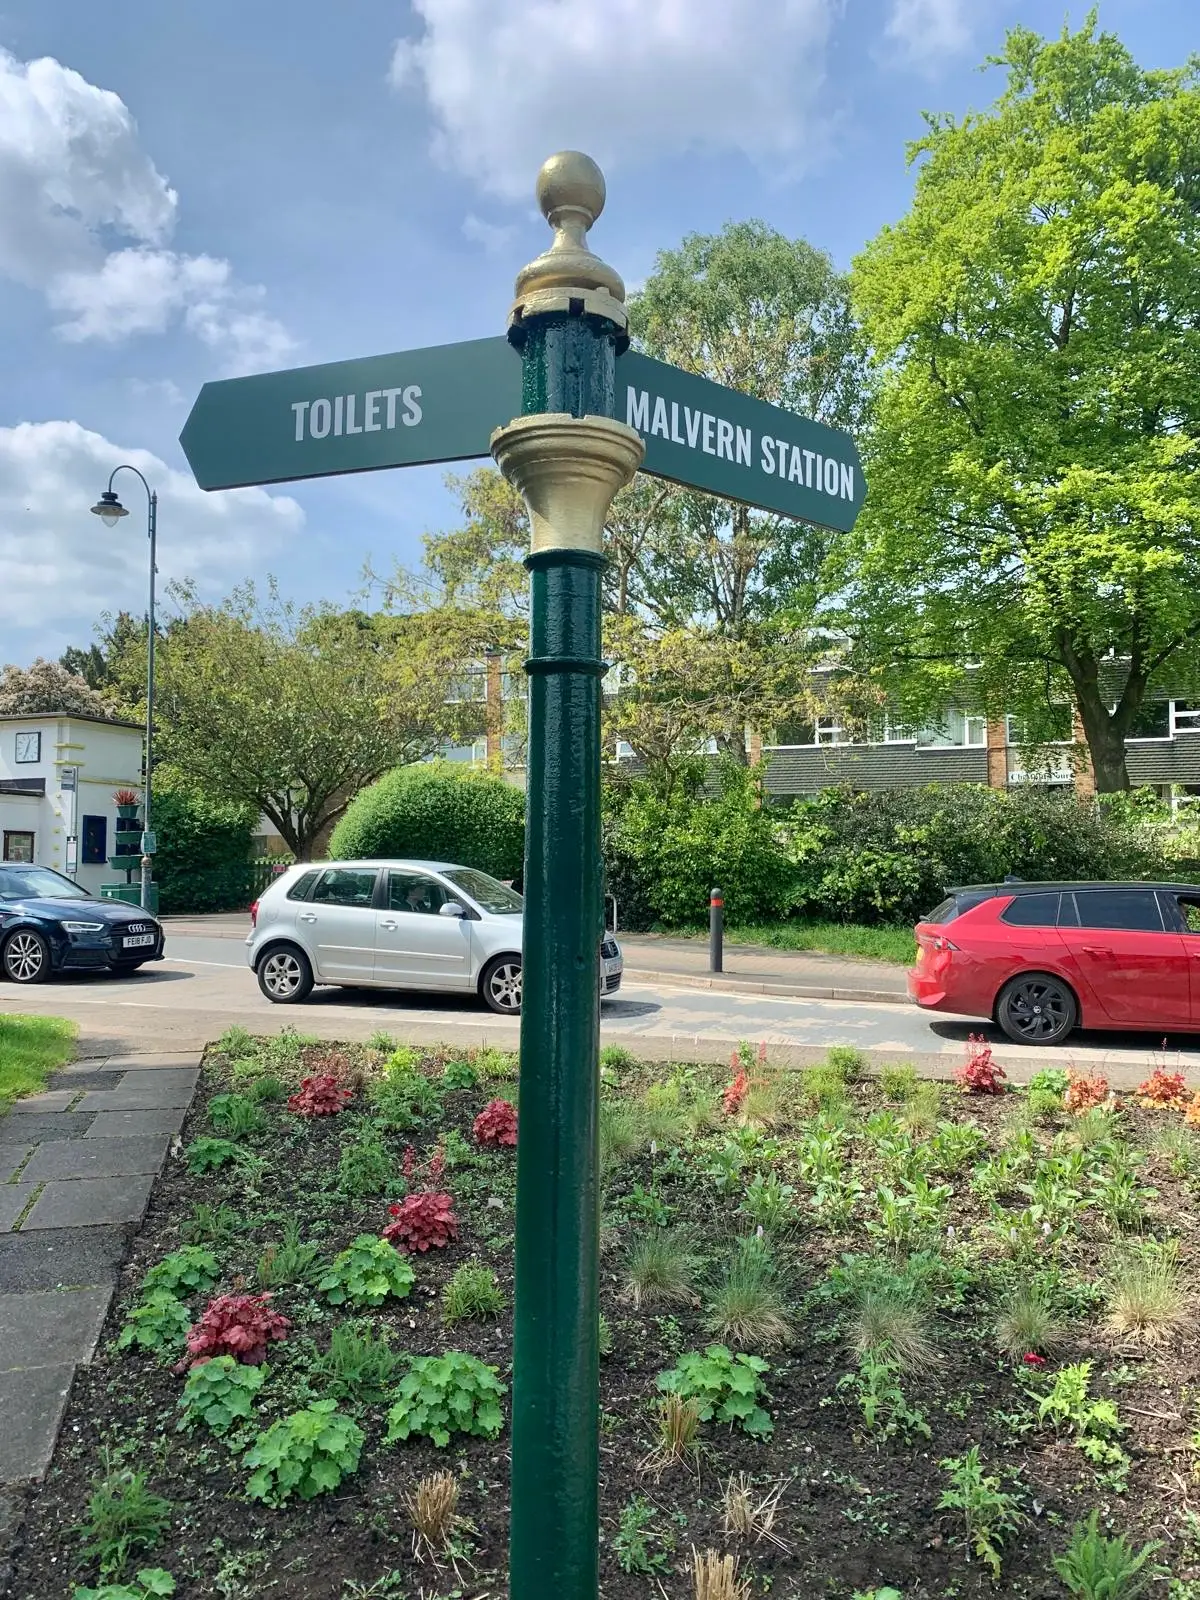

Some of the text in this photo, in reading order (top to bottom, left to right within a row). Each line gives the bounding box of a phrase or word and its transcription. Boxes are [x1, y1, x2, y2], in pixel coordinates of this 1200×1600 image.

[291, 385, 422, 441] TOILETS
[626, 386, 854, 502] MALVERN STATION
